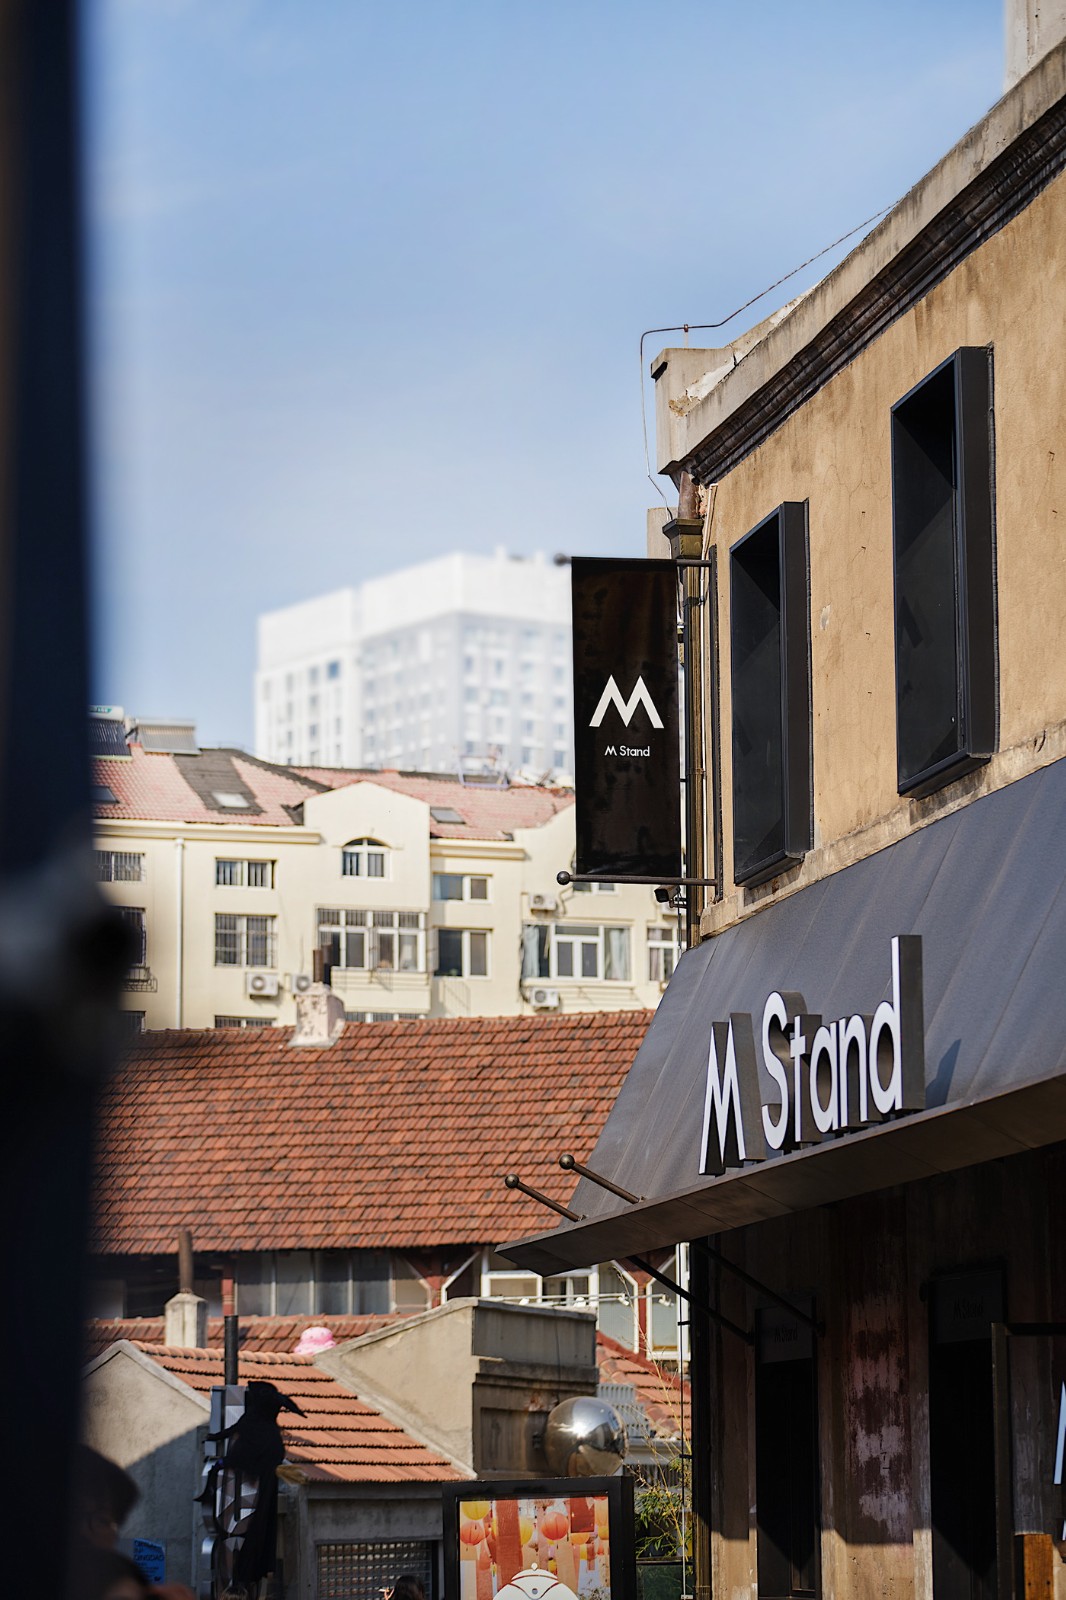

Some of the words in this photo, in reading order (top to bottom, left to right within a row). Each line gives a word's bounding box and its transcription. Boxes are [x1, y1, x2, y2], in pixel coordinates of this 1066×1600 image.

[588, 674, 664, 729] M
[604, 745, 618, 756] M
[619, 745, 650, 757] Stand
[699, 1017, 747, 1175] M
[762, 934, 903, 1150] Stand
